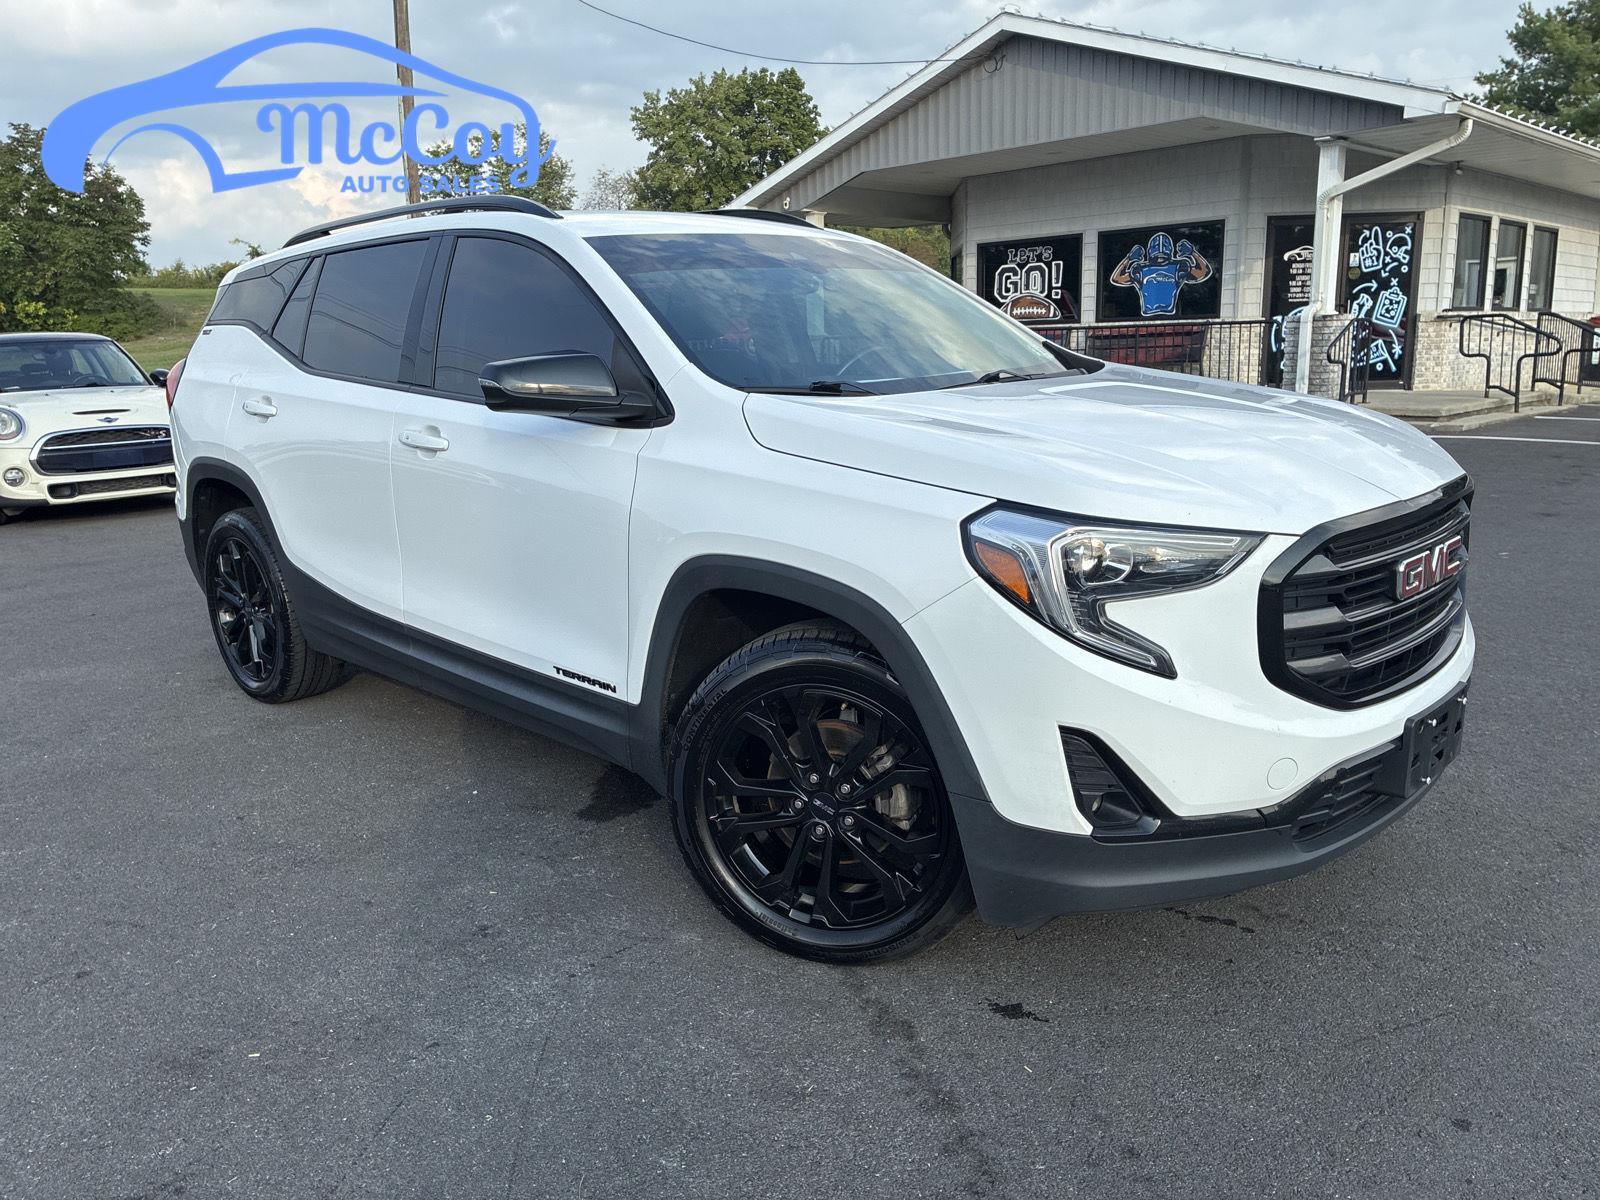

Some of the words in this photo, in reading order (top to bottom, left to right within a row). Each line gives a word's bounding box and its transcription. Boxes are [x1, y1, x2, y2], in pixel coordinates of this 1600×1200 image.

[994, 260, 1063, 302] GO!
[1364, 255, 1378, 268] #1
[1396, 535, 1462, 601] GMC
[553, 665, 617, 693] TERRAIN
[681, 688, 728, 752] CONTINENTAL
